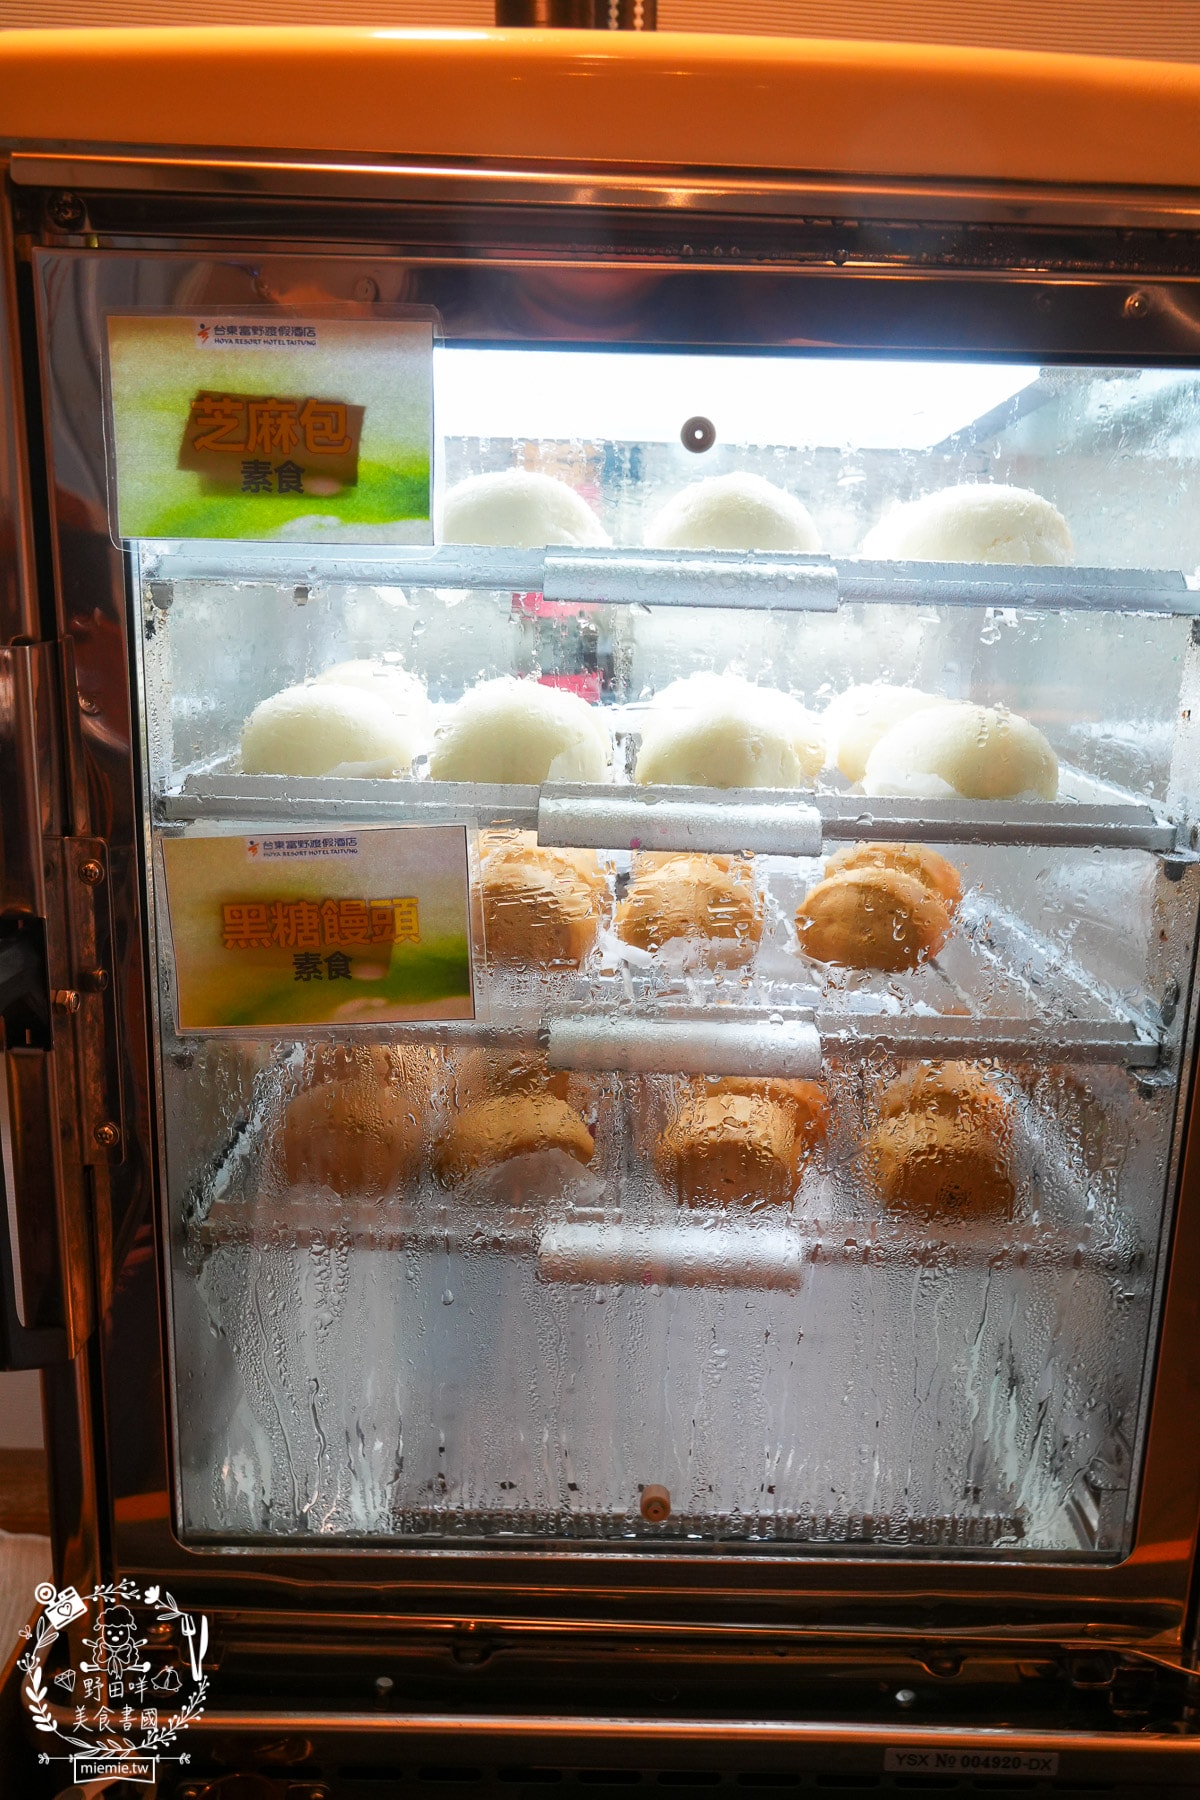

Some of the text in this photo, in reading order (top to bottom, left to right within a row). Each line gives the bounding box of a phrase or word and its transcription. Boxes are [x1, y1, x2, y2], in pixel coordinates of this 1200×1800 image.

[213, 325, 317, 338] 台東富野渡假酒店
[191, 399, 352, 455] 芝麻包
[240, 460, 305, 495] 素食
[262, 837, 358, 850] 台東富野渡假酒店
[222, 898, 422, 949] 黑糖饅頭
[292, 951, 353, 982] 素食
[1031, 1539, 1067, 1549] GLASS
[895, 1753, 930, 1767] YSX
[960, 1754, 1053, 1771] 004920-DX
